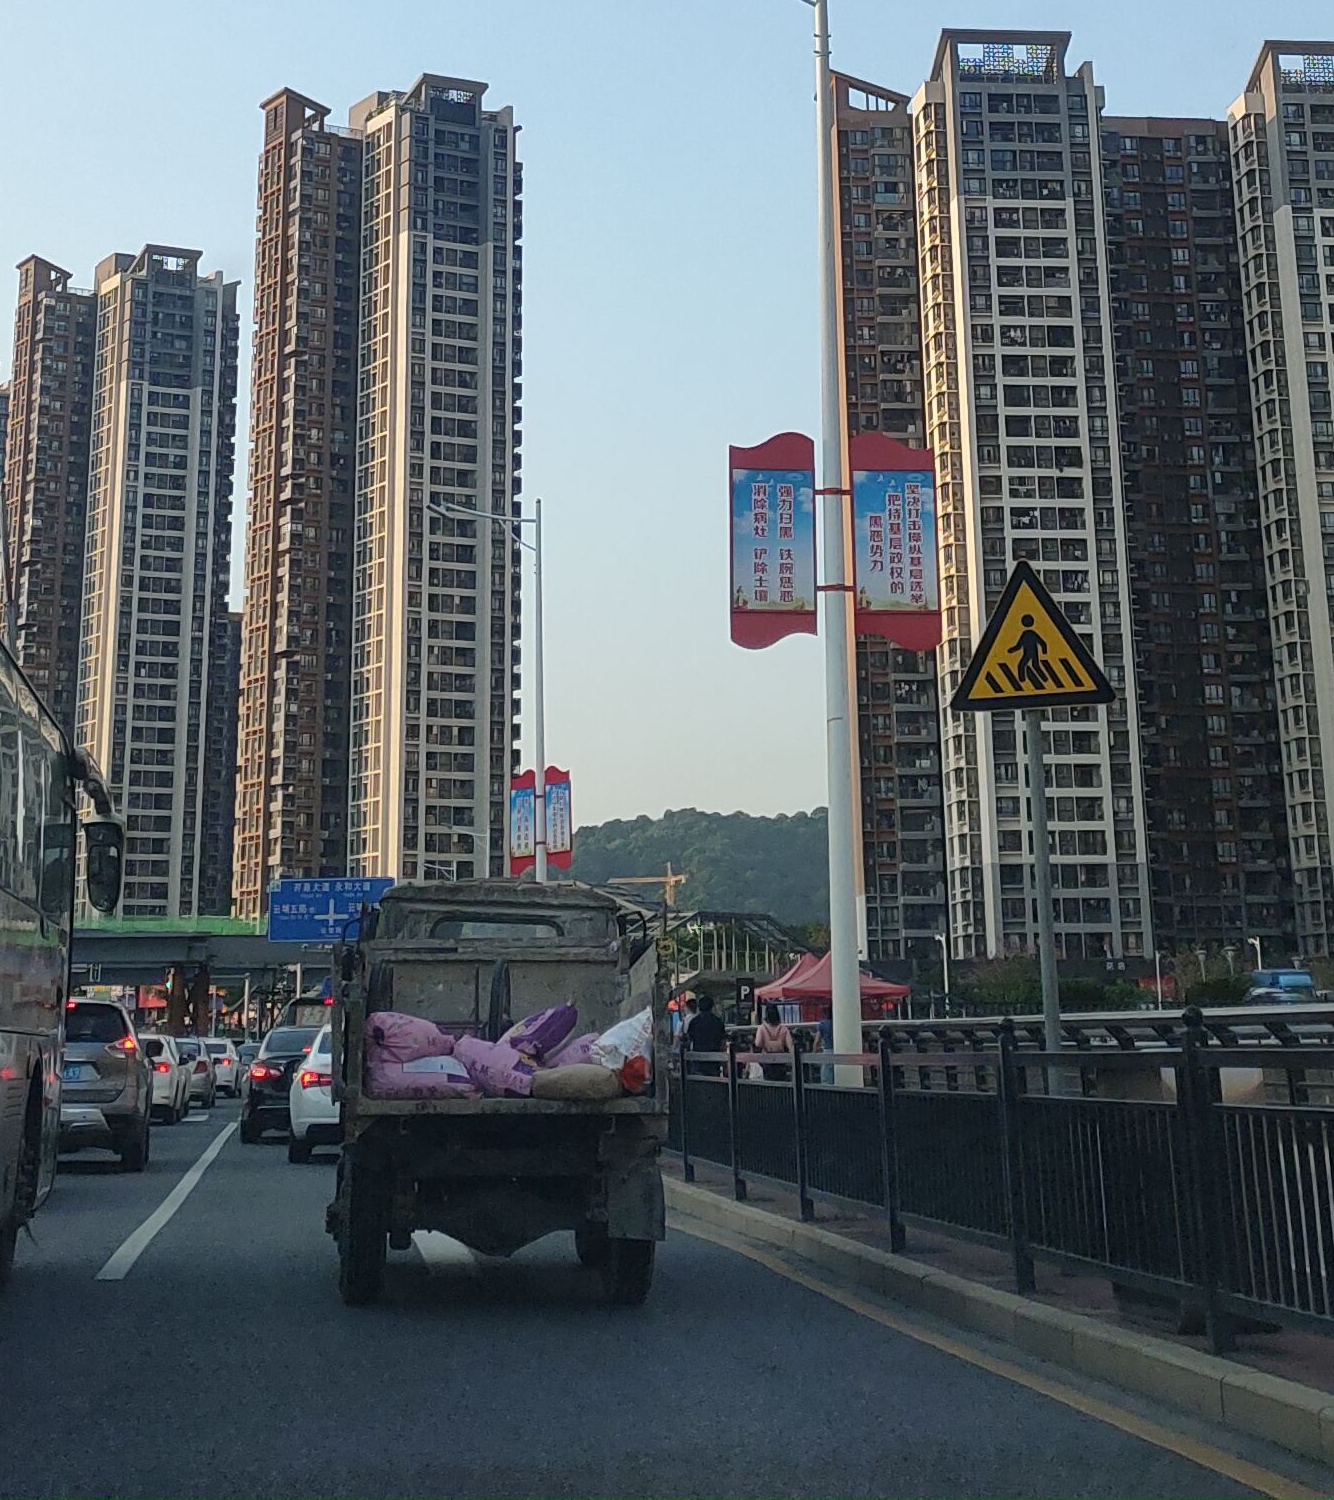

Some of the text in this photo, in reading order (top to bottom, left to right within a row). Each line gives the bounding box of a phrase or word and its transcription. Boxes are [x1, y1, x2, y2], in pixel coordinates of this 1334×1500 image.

[752, 483, 770, 603] 消除病灶 铲除土壤
[778, 484, 795, 604] 强力扫黑 铁腕惩恶
[868, 515, 885, 574] 黑恶势力
[886, 493, 905, 595] 把持基层政权的
[906, 484, 924, 604] 坚决打击操纵基层选举
[740, 985, 750, 1000] P
